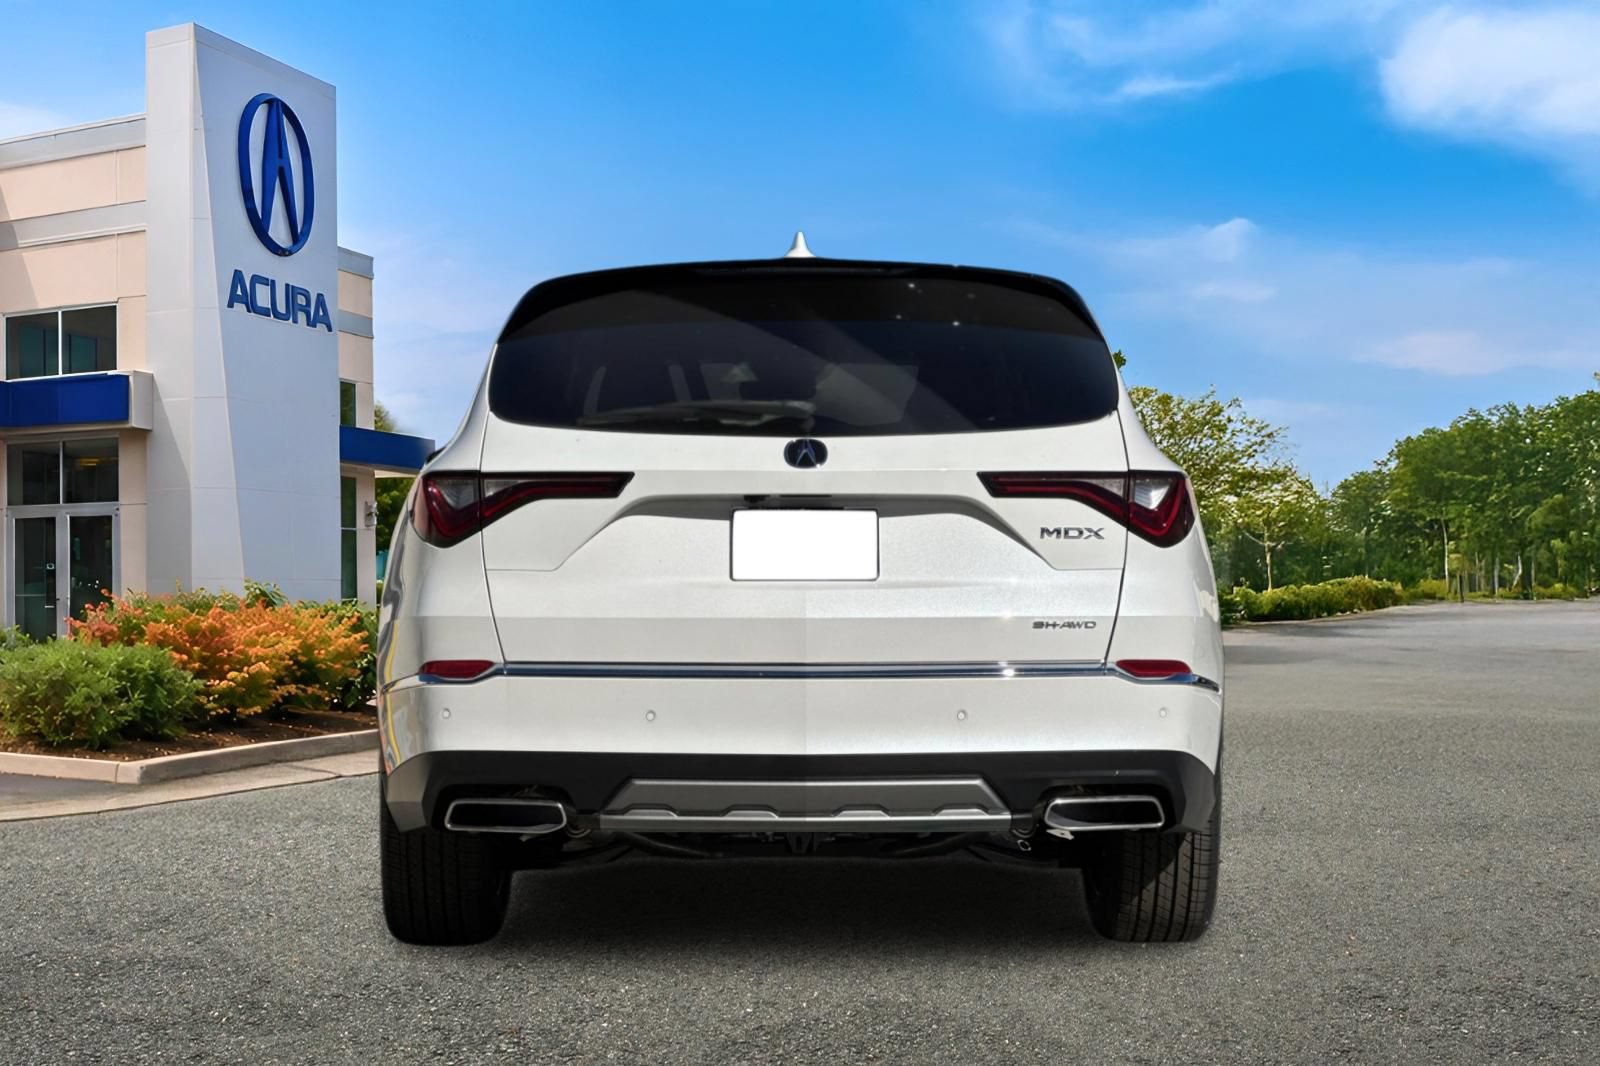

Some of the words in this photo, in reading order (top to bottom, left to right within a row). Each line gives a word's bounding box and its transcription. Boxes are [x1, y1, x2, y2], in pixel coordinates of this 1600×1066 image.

[227, 269, 333, 333] ACURA
[1040, 527, 1105, 540] MDX
[1032, 620, 1097, 630] SH-AWD
